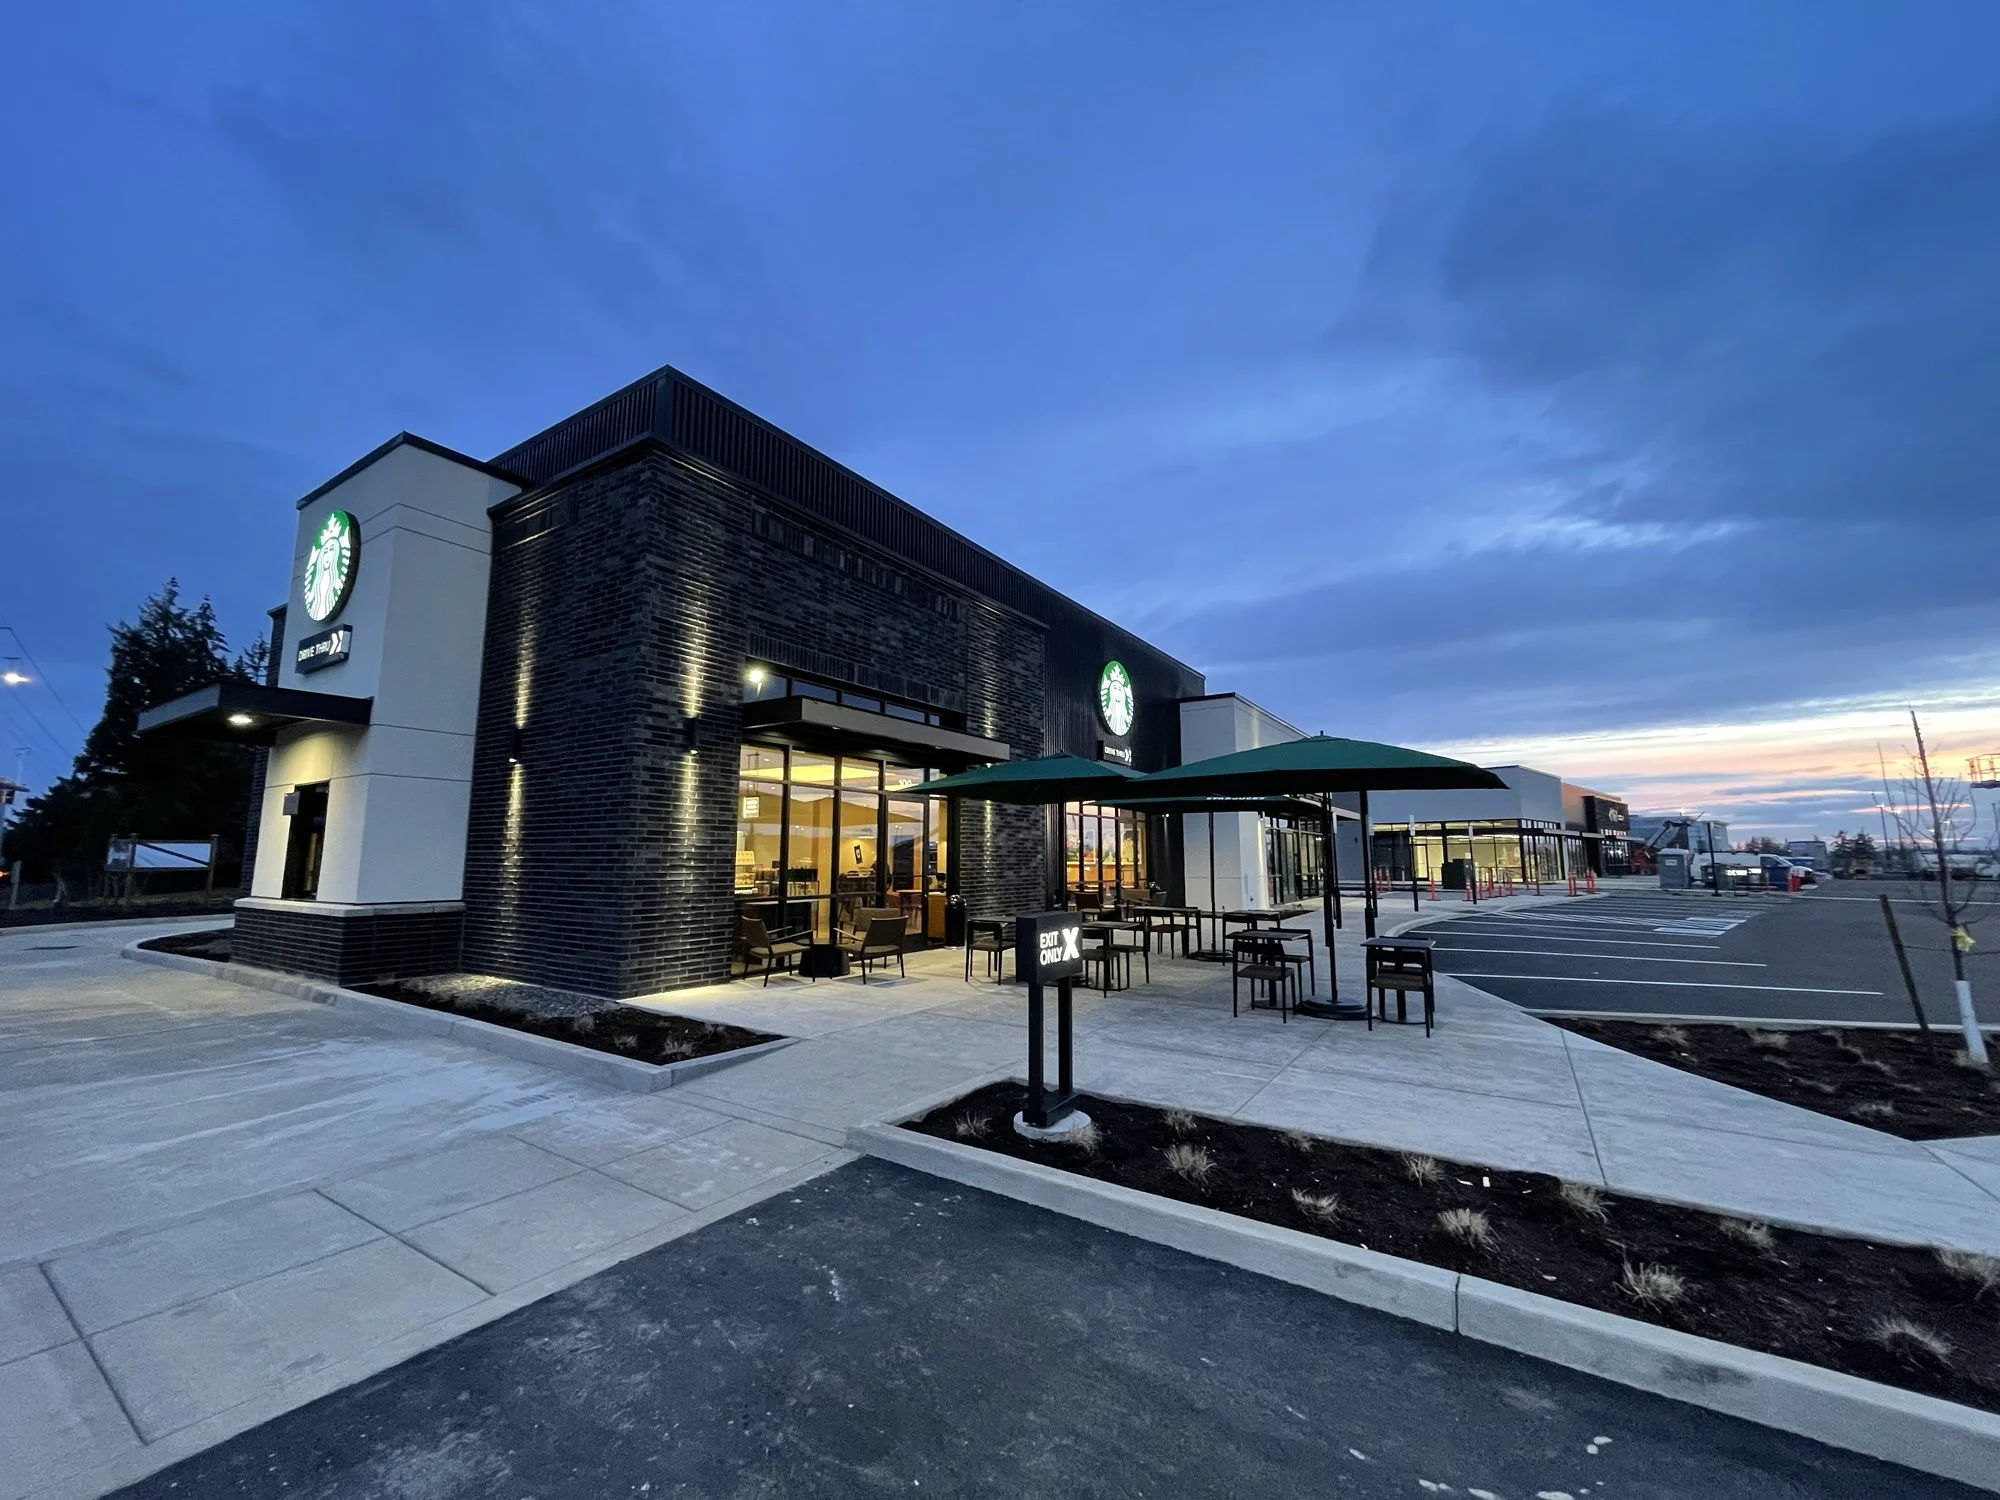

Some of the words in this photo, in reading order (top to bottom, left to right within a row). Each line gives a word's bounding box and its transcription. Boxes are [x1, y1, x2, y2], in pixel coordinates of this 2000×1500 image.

[298, 646, 315, 662] DRIVE
[315, 640, 331, 655] THRU
[1040, 931, 1059, 949] EXIT
[1040, 947, 1063, 965] ONLY
